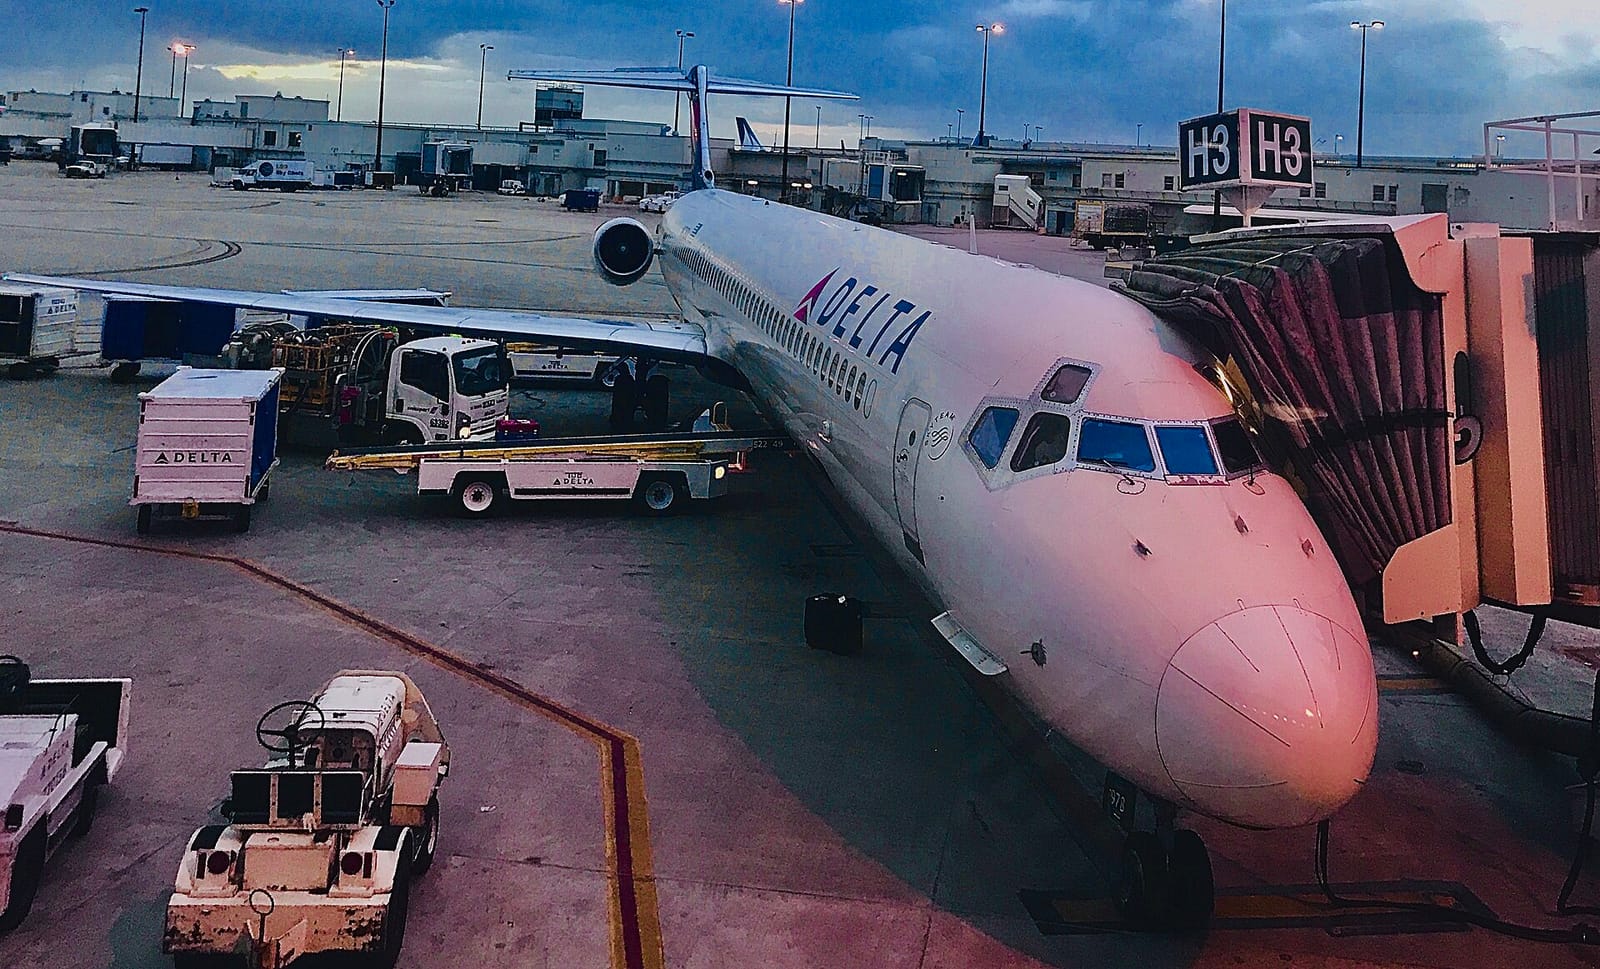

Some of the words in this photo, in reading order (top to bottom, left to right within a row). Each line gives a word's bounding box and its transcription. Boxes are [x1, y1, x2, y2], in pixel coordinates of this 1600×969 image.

[1188, 124, 1230, 178] H3
[1258, 121, 1303, 177] H3
[816, 277, 932, 376] DELTA
[174, 452, 232, 463] DELTA
